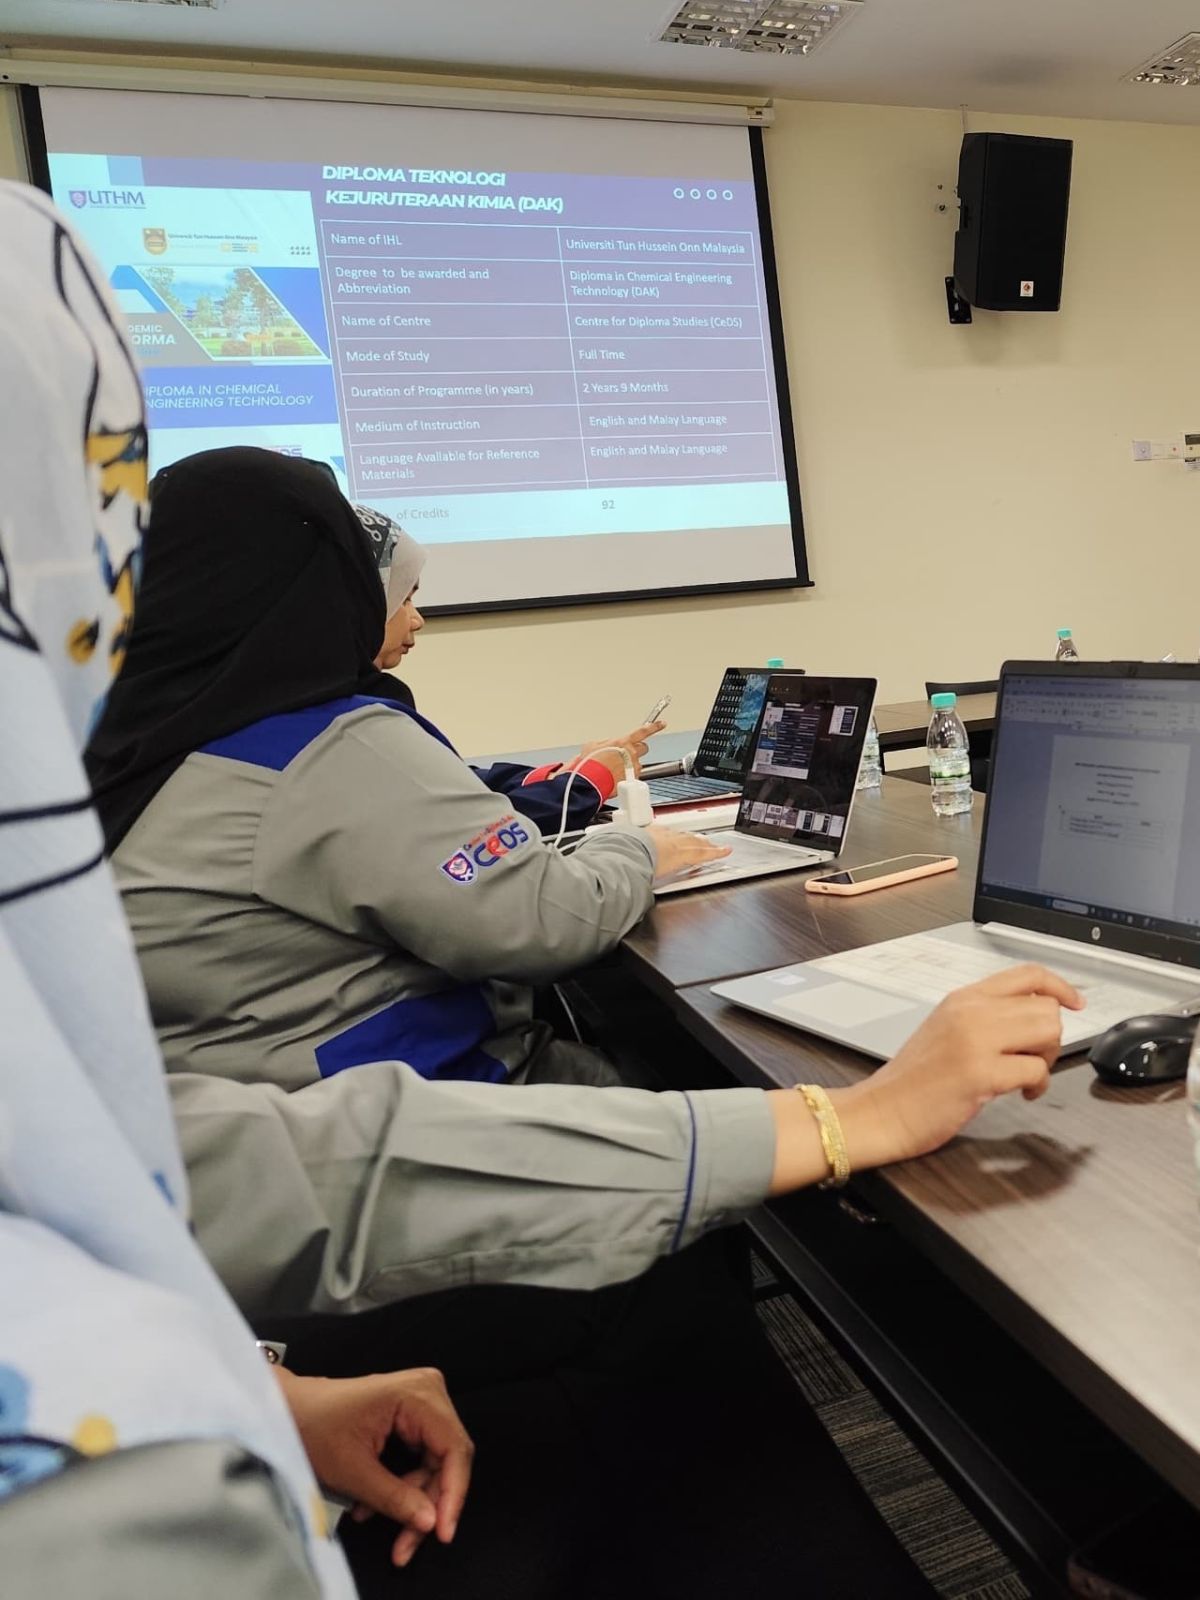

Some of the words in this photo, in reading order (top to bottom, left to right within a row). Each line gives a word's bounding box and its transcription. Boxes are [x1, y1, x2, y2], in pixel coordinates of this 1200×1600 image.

[322, 165, 406, 183] DIPLOMA
[409, 169, 506, 186] TEKNOLOGI
[88, 190, 145, 205] UTHM
[326, 190, 465, 208] KEJURUTERAAN
[468, 194, 515, 210] KIMIA
[518, 197, 564, 214] (DAK)
[331, 233, 366, 245] Name
[368, 233, 382, 245] of
[383, 234, 402, 246] IHL
[566, 239, 615, 250] Universiti
[617, 240, 635, 251] Tun
[638, 241, 677, 252] Hussein
[679, 242, 700, 252] Onn
[702, 243, 745, 255] Malaysia
[335, 266, 377, 281] Degree
[383, 267, 395, 278] to
[401, 267, 416, 278] be
[418, 267, 466, 279] awarded
[469, 268, 490, 280] and
[569, 270, 613, 284] Diploma
[615, 271, 625, 281] in
[627, 271, 673, 282] Chemical
[675, 272, 732, 285] Engineering
[337, 282, 411, 295] Abbreviation
[571, 285, 629, 298] Technology
[631, 286, 660, 298] (DAK)
[342, 315, 376, 327] Name
[379, 315, 392, 327] of
[393, 315, 432, 327] Centre
[575, 316, 609, 327] Centre
[611, 316, 627, 327] for
[629, 316, 670, 329] Diploma
[672, 316, 709, 327] Studies
[710, 316, 743, 329] (CeDS)
[128, 324, 163, 333] DEMIC
[131, 334, 176, 345] ORMA
[346, 351, 380, 362] Mode
[384, 350, 396, 361] of
[397, 351, 430, 363] Study
[579, 349, 597, 360] Full
[600, 349, 626, 360] Time
[146, 385, 194, 396] IPLOMA
[198, 385, 212, 395] IN
[215, 383, 281, 395] CHEMICAL
[351, 386, 401, 398] Duration
[404, 385, 416, 396] of
[418, 385, 482, 398] Programme
[485, 384, 500, 397] (in
[501, 383, 534, 396] years)
[583, 383, 590, 393] 2
[591, 383, 619, 393] Years
[621, 383, 628, 393] 9
[630, 382, 669, 393] Months
[146, 396, 224, 409] NGINEERING
[228, 395, 314, 407] TECHNOLOGY
[355, 420, 403, 432] Medium
[406, 420, 418, 431] of
[421, 419, 480, 431] Instruction
[589, 415, 625, 428] English
[628, 415, 646, 425] and
[649, 414, 679, 427] Malay
[682, 413, 728, 427] Language
[590, 445, 626, 458] English
[628, 444, 647, 455] and
[650, 443, 680, 456] Malay
[682, 443, 728, 456] Language
[360, 453, 414, 466] Language
[416, 451, 466, 463] Available
[468, 450, 484, 461] for
[487, 449, 540, 460] Reference
[362, 468, 415, 481] Materials
[602, 500, 615, 510] 92
[397, 509, 407, 520] of
[410, 507, 449, 519] Credits
